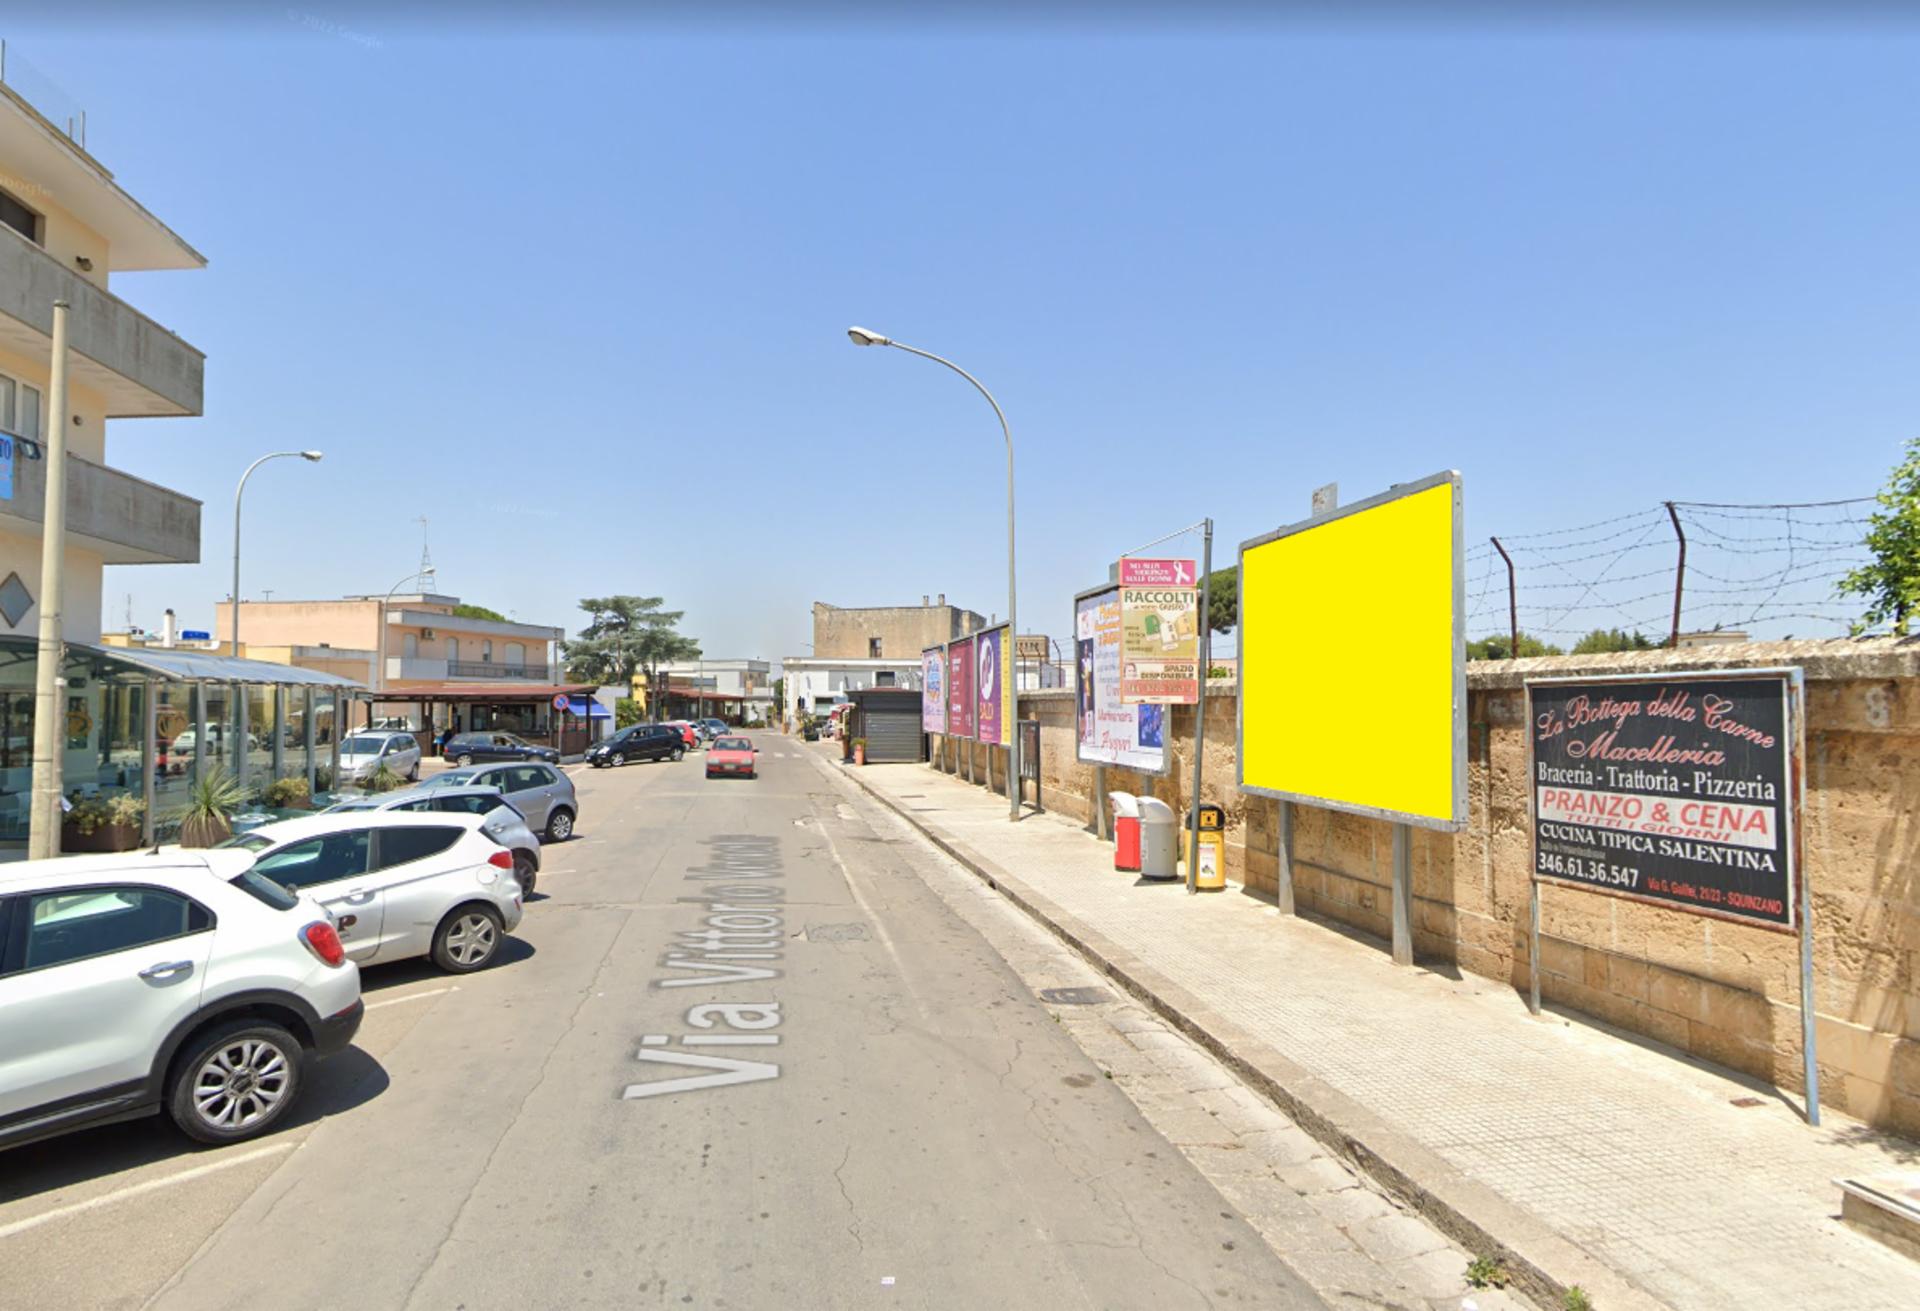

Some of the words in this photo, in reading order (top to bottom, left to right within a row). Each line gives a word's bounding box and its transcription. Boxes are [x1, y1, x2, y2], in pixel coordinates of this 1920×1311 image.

[1124, 591, 1194, 604] RACCOLTI
[1537, 709, 1564, 740] La
[1566, 693, 1641, 730] Bottega
[1646, 687, 1696, 722] della
[1702, 693, 1775, 749] Carne
[1567, 731, 1726, 766] Macelleria
[1538, 761, 1594, 785] Braceria
[1606, 766, 1679, 792] Trattoria
[1693, 771, 1777, 800] Pizzeria
[1542, 788, 1643, 820] PRANZO
[1651, 802, 1670, 823] &
[1680, 802, 1768, 835] CENA
[1540, 822, 1597, 845] CUCINA
[1598, 831, 1655, 854] TIPICA
[1659, 839, 1777, 873] SALENTINA
[1640, 822, 1732, 842] GIORNI
[1538, 852, 1639, 887] 346.61.36.547
[1727, 891, 1784, 915] SQUINZANO
